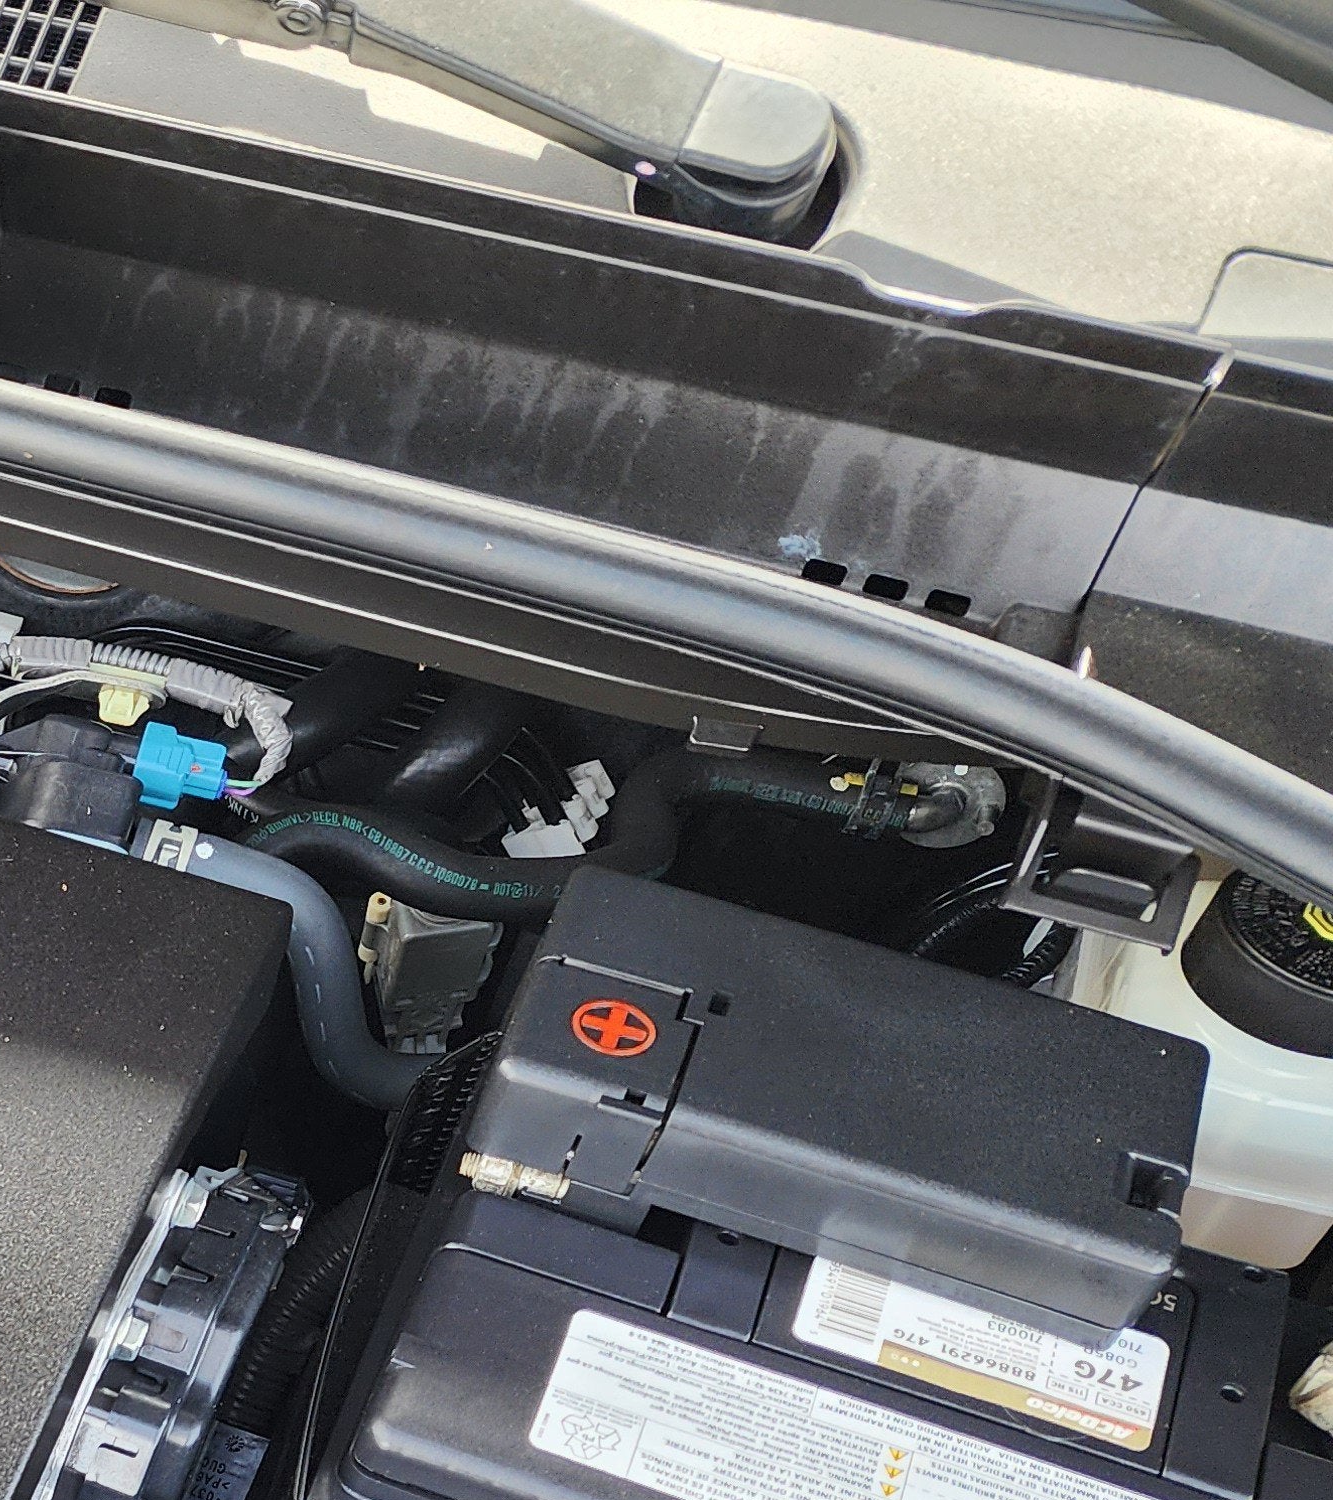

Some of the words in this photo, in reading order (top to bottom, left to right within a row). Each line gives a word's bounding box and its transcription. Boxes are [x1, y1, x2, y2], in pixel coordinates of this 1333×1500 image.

[891, 1327, 930, 1347] 47G
[985, 1319, 1044, 1344] 710083
[940, 1343, 1036, 1381] 88866291
[1071, 1358, 1144, 1395] 47G
[1100, 1396, 1123, 1408] CCA
[1023, 1394, 1136, 1443] ACDelco
